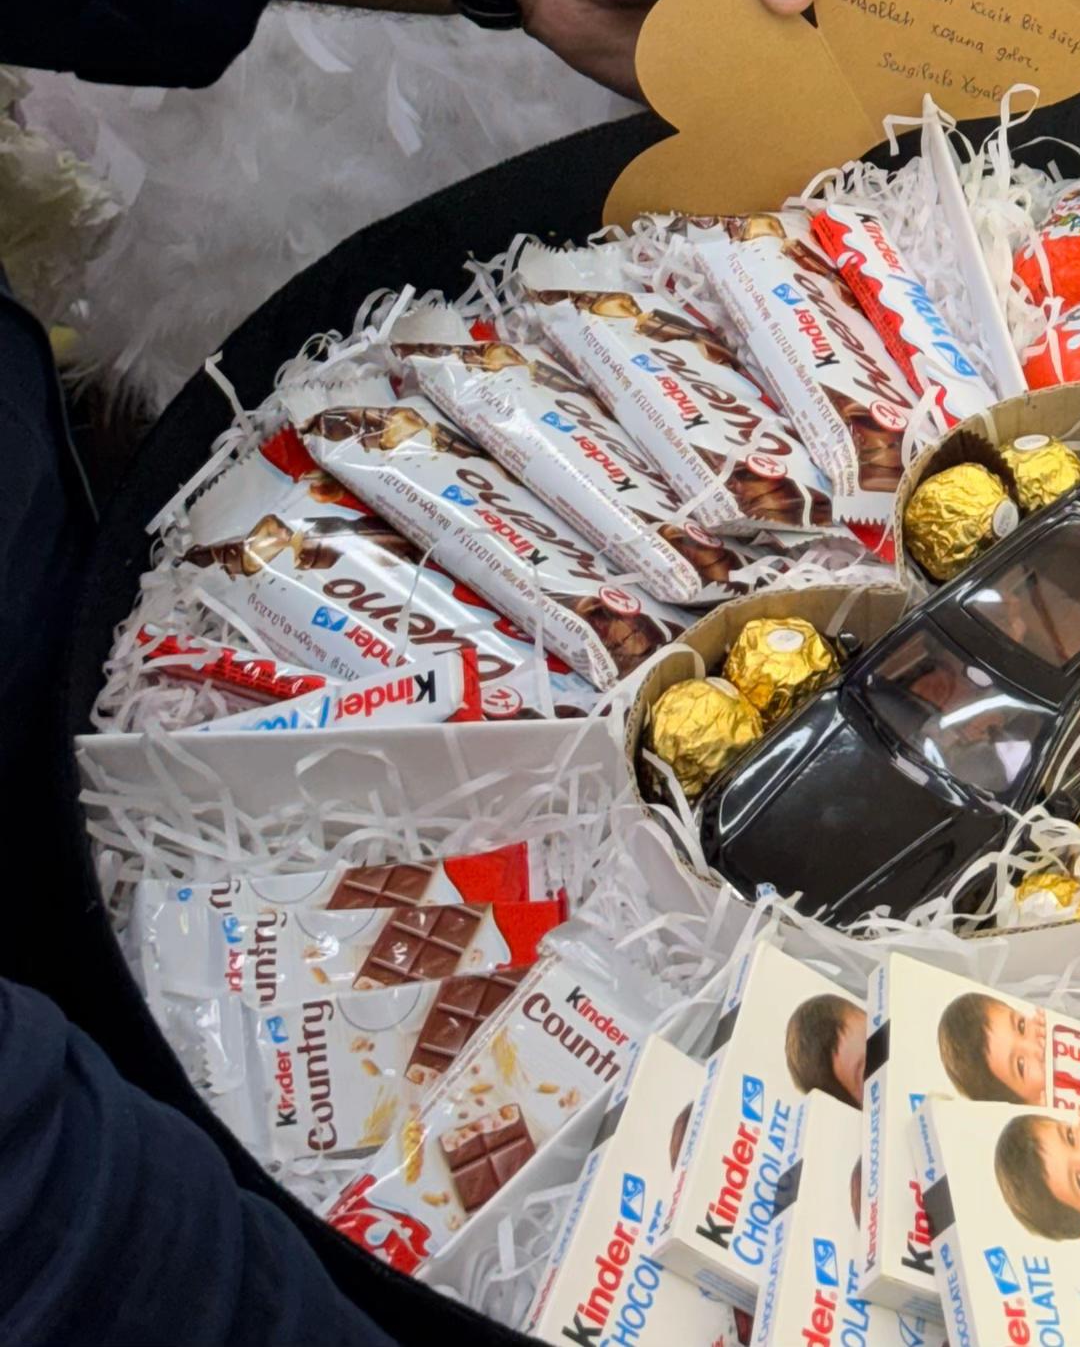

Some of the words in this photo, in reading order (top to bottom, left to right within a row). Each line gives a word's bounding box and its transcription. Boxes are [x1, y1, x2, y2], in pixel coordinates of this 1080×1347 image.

[792, 307, 840, 368] Kinder
[654, 374, 710, 431] Kinder
[570, 434, 639, 493] Kinder
[473, 508, 549, 566] Kinder
[333, 669, 436, 721] Kinder
[565, 985, 630, 1046] Kinder
[275, 1048, 297, 1127] Kinder
[297, 999, 338, 1151] Country
[695, 1121, 761, 1250] Kinder
[561, 1220, 636, 1347] Kinder
